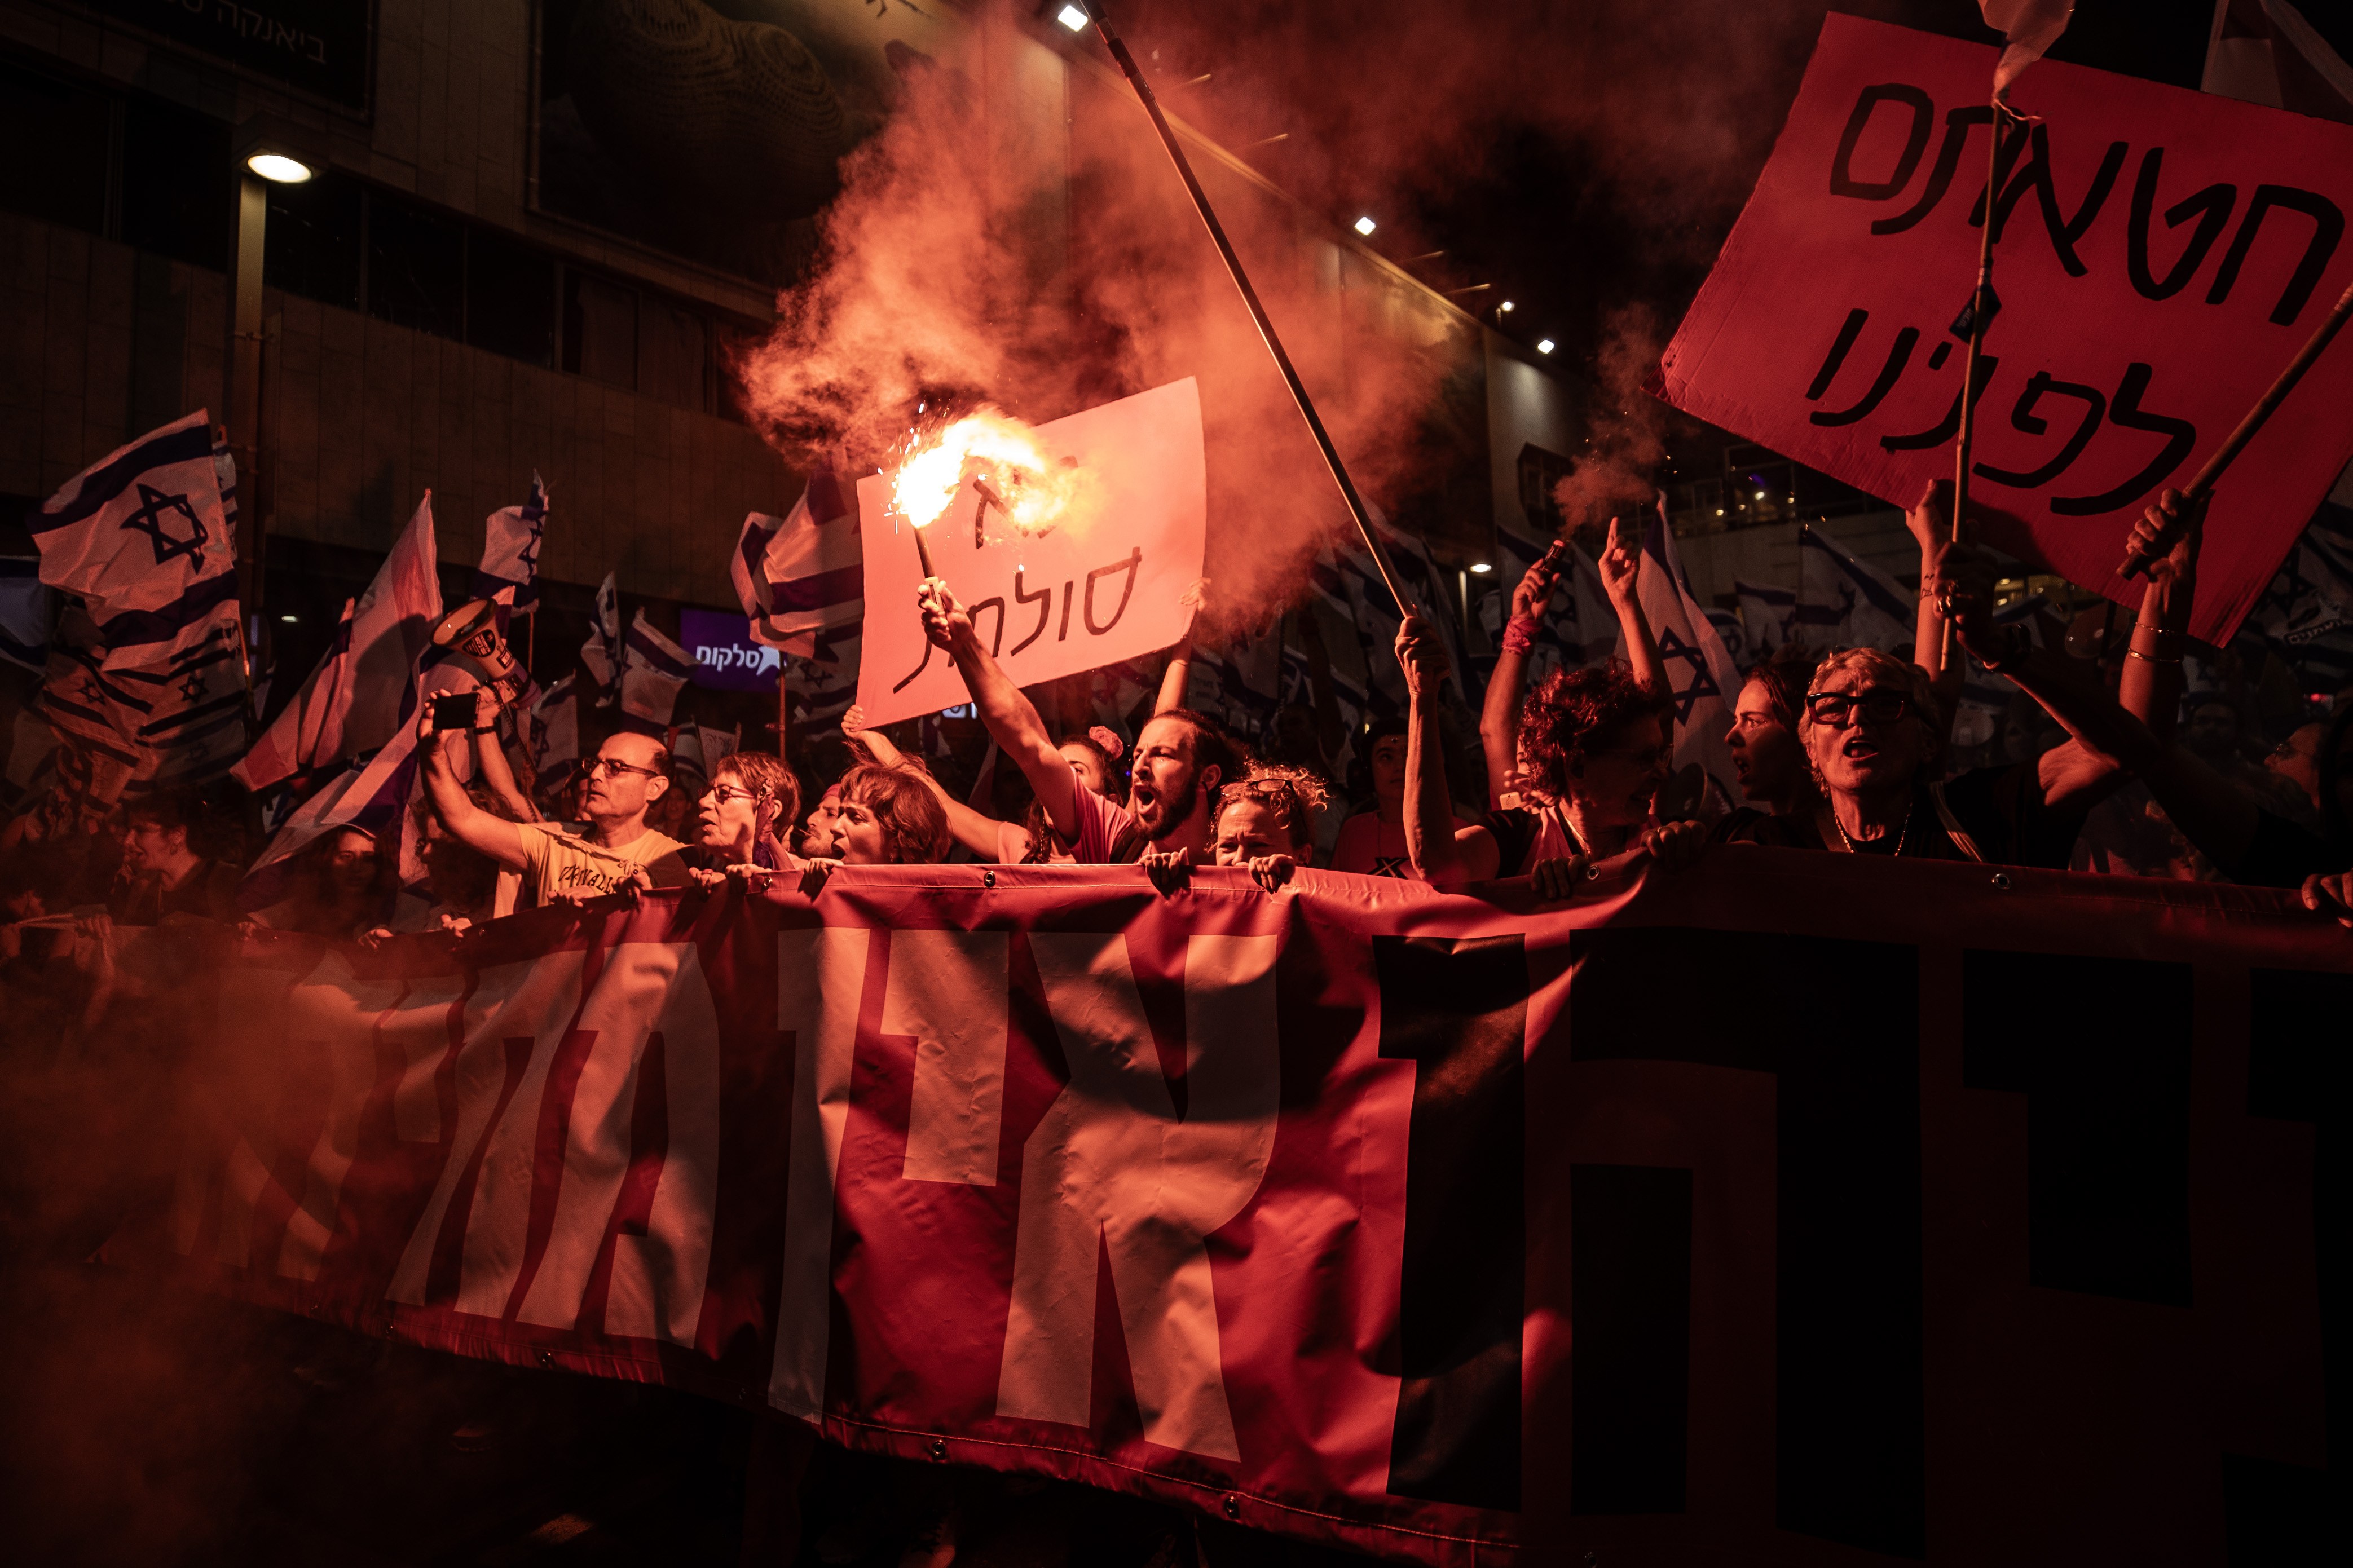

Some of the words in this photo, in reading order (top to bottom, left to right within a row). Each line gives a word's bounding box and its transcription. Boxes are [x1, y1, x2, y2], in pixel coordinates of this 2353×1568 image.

[1830, 84, 2345, 326] חטאתם
[695, 643, 761, 673] סלקום
[768, 926, 1281, 1463] אין
